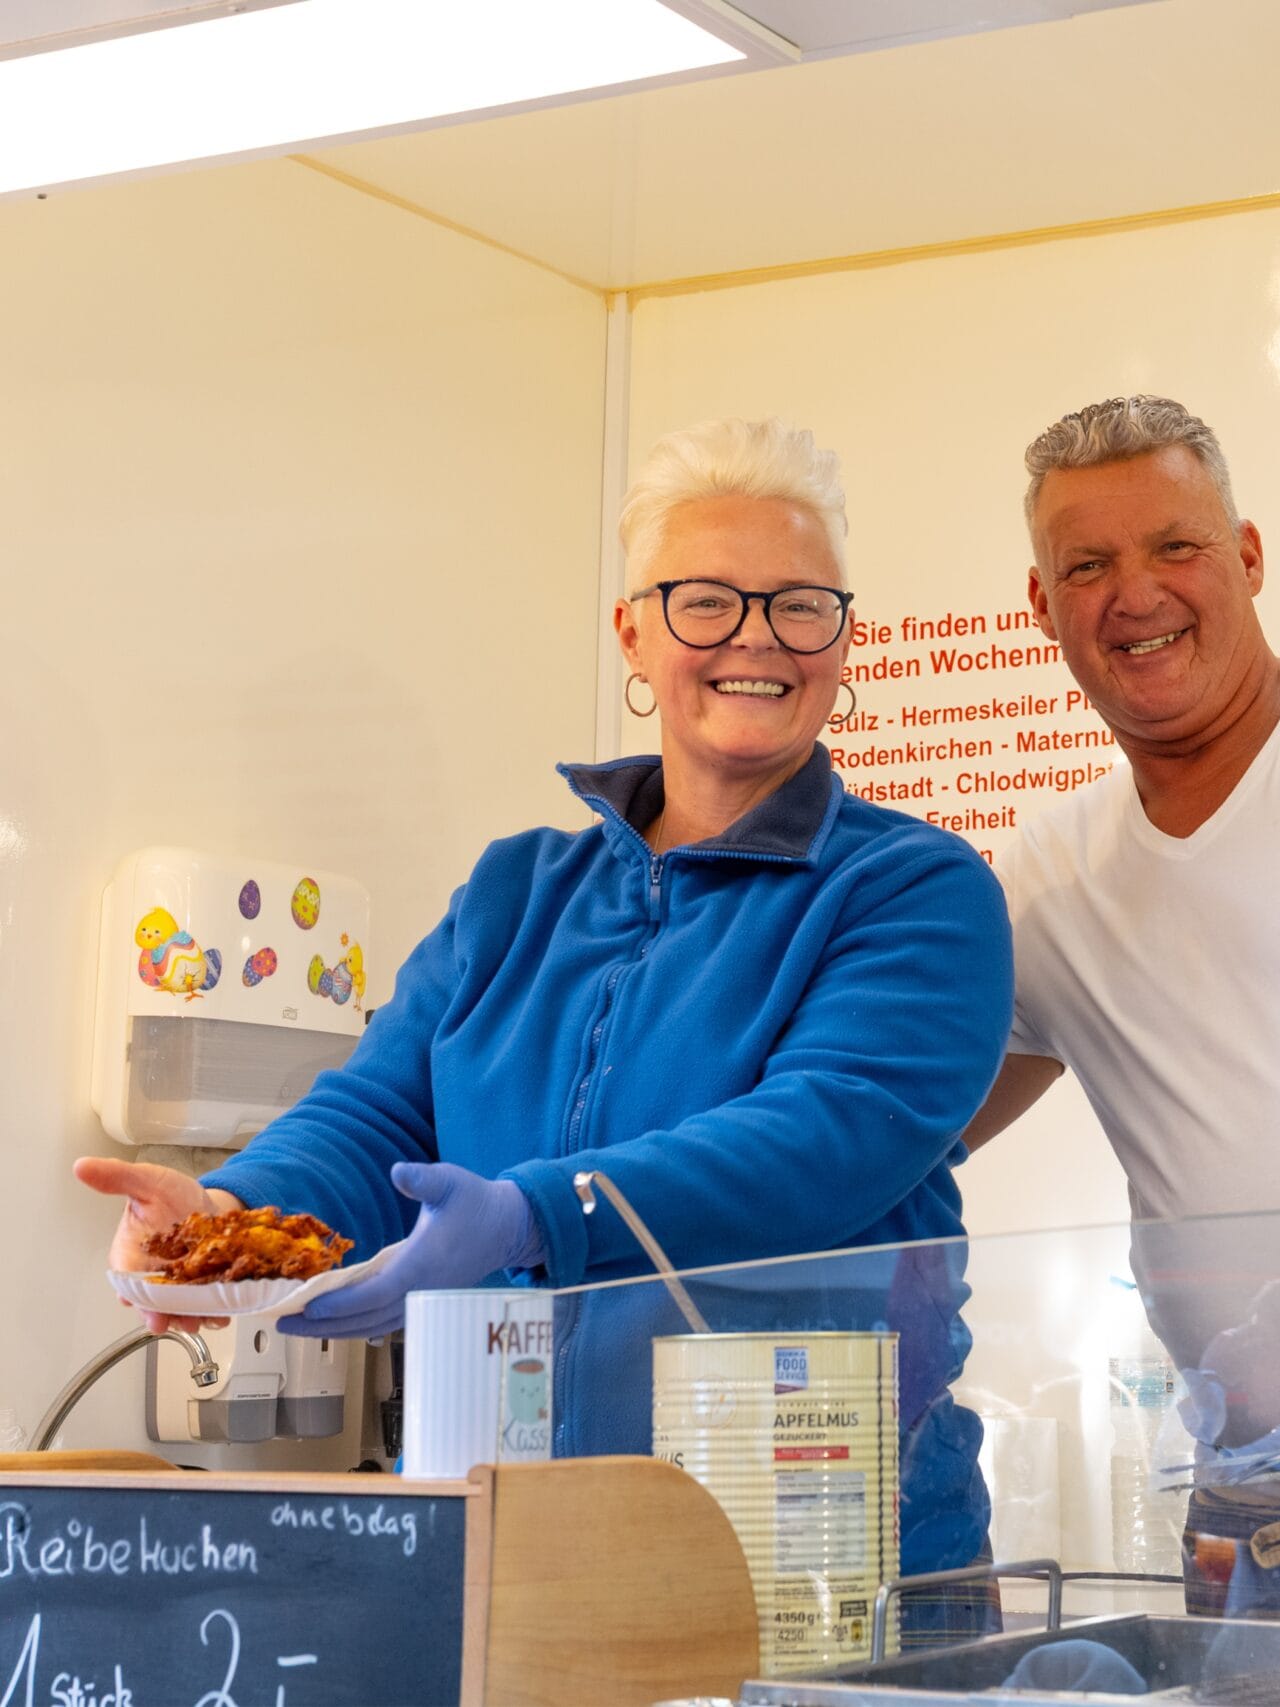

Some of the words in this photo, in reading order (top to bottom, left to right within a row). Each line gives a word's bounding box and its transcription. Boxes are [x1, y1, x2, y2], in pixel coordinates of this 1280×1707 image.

[851, 620, 892, 647] Sie
[901, 612, 987, 642] finden
[841, 655, 921, 684] enden
[901, 693, 1059, 729] Hermeskeiler
[830, 737, 993, 770] Rodenkirchen
[926, 805, 1016, 832] Freiheit
[775, 1357, 807, 1371] FOOD
[773, 1411, 860, 1428] APFELMUS
